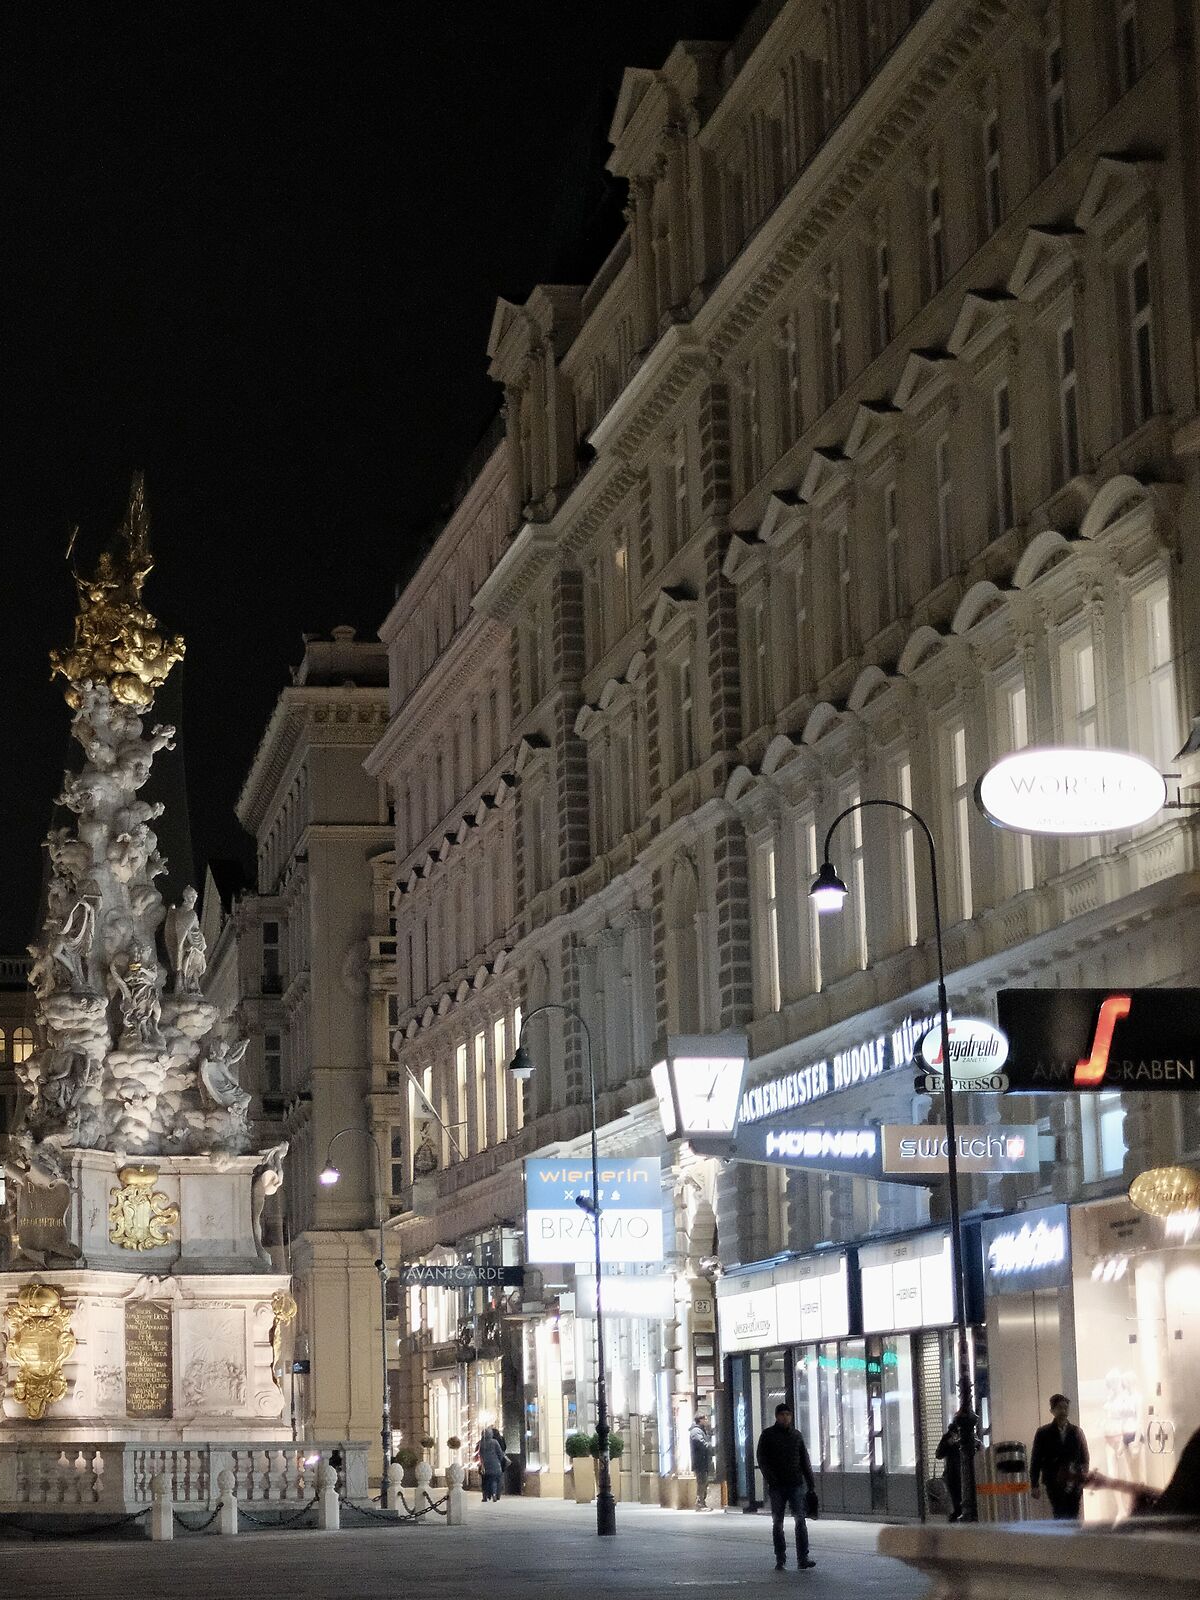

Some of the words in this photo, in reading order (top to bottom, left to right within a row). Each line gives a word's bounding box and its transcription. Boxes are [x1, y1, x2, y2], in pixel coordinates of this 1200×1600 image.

[833, 1034, 885, 1091] RUDOLF
[931, 1075, 1003, 1090] EPRESSO
[766, 1130, 876, 1158] HÜBNER
[539, 1168, 648, 1183] wienerin
[541, 1216, 649, 1239] BRAMO
[406, 1267, 505, 1280] AVANTGARDE
[697, 1302, 708, 1311] 27
